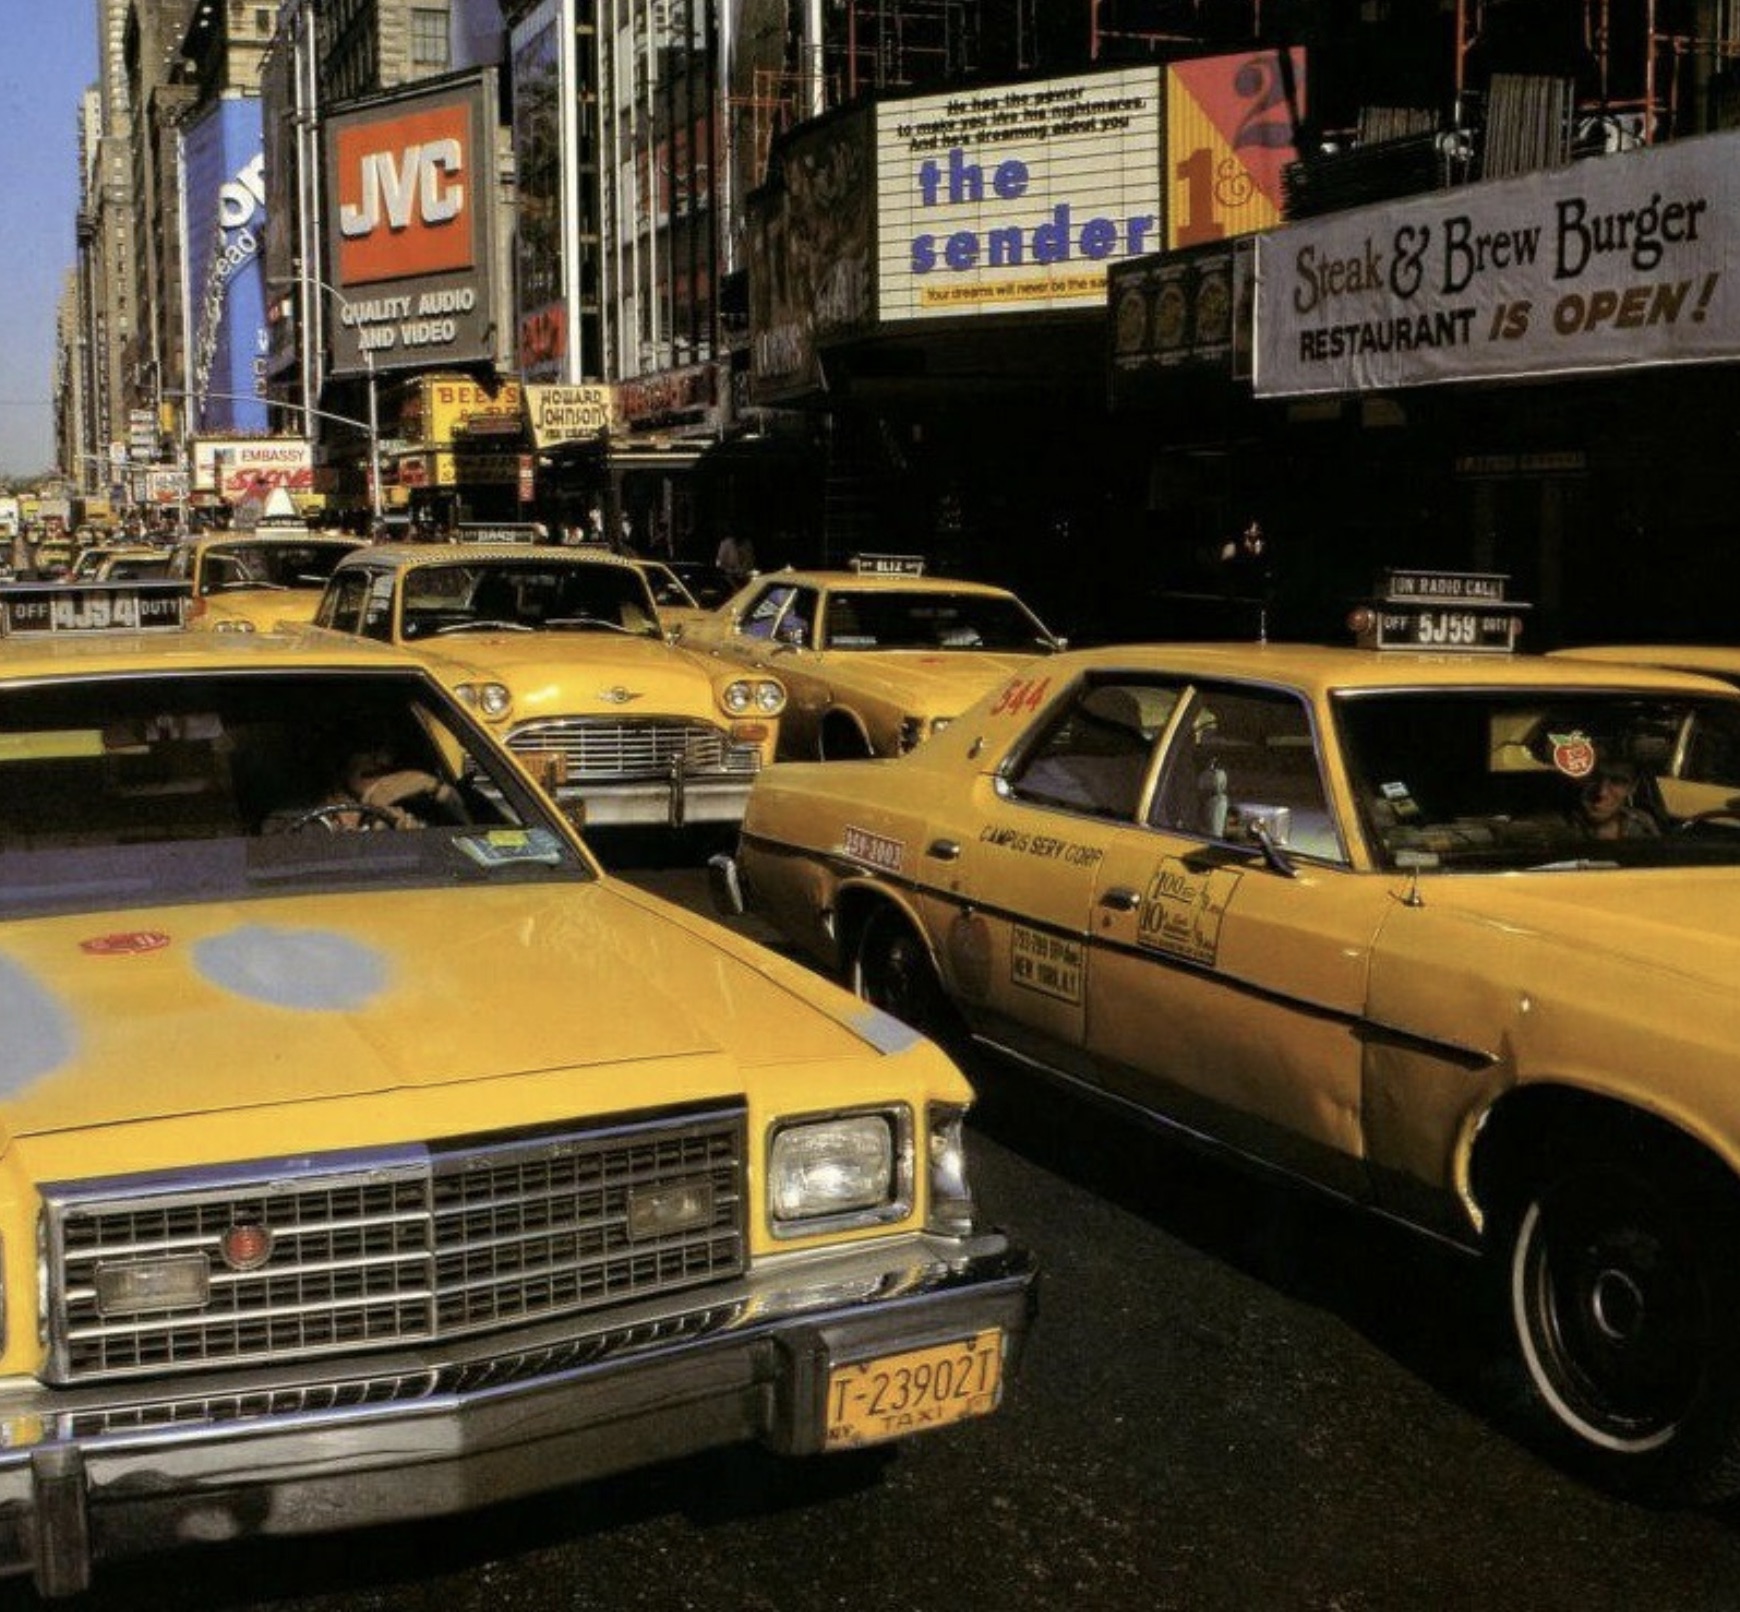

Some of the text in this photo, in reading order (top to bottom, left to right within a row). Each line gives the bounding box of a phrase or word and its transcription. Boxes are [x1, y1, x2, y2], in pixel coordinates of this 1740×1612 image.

[340, 138, 464, 236] JVC
[919, 147, 1029, 207] the
[911, 203, 1154, 275] sender
[1293, 239, 1385, 314] Steak
[1389, 225, 1430, 300] &
[1441, 215, 1542, 296] Brew
[1553, 193, 1708, 281] Burger
[341, 287, 475, 326] QUALITY AUDIO
[358, 317, 457, 350] AND VIDEO
[1300, 308, 1477, 363] RESTAURANT
[1488, 299, 1533, 342] IS
[541, 389, 602, 406] HOWARD
[242, 449, 304, 463] EMBASSY
[15, 602, 48, 619] OFF
[141, 598, 178, 616] DUTY
[1418, 612, 1477, 643] 5J59
[836, 1348, 993, 1422] T-23902T
[880, 1408, 942, 1430] TAXI
